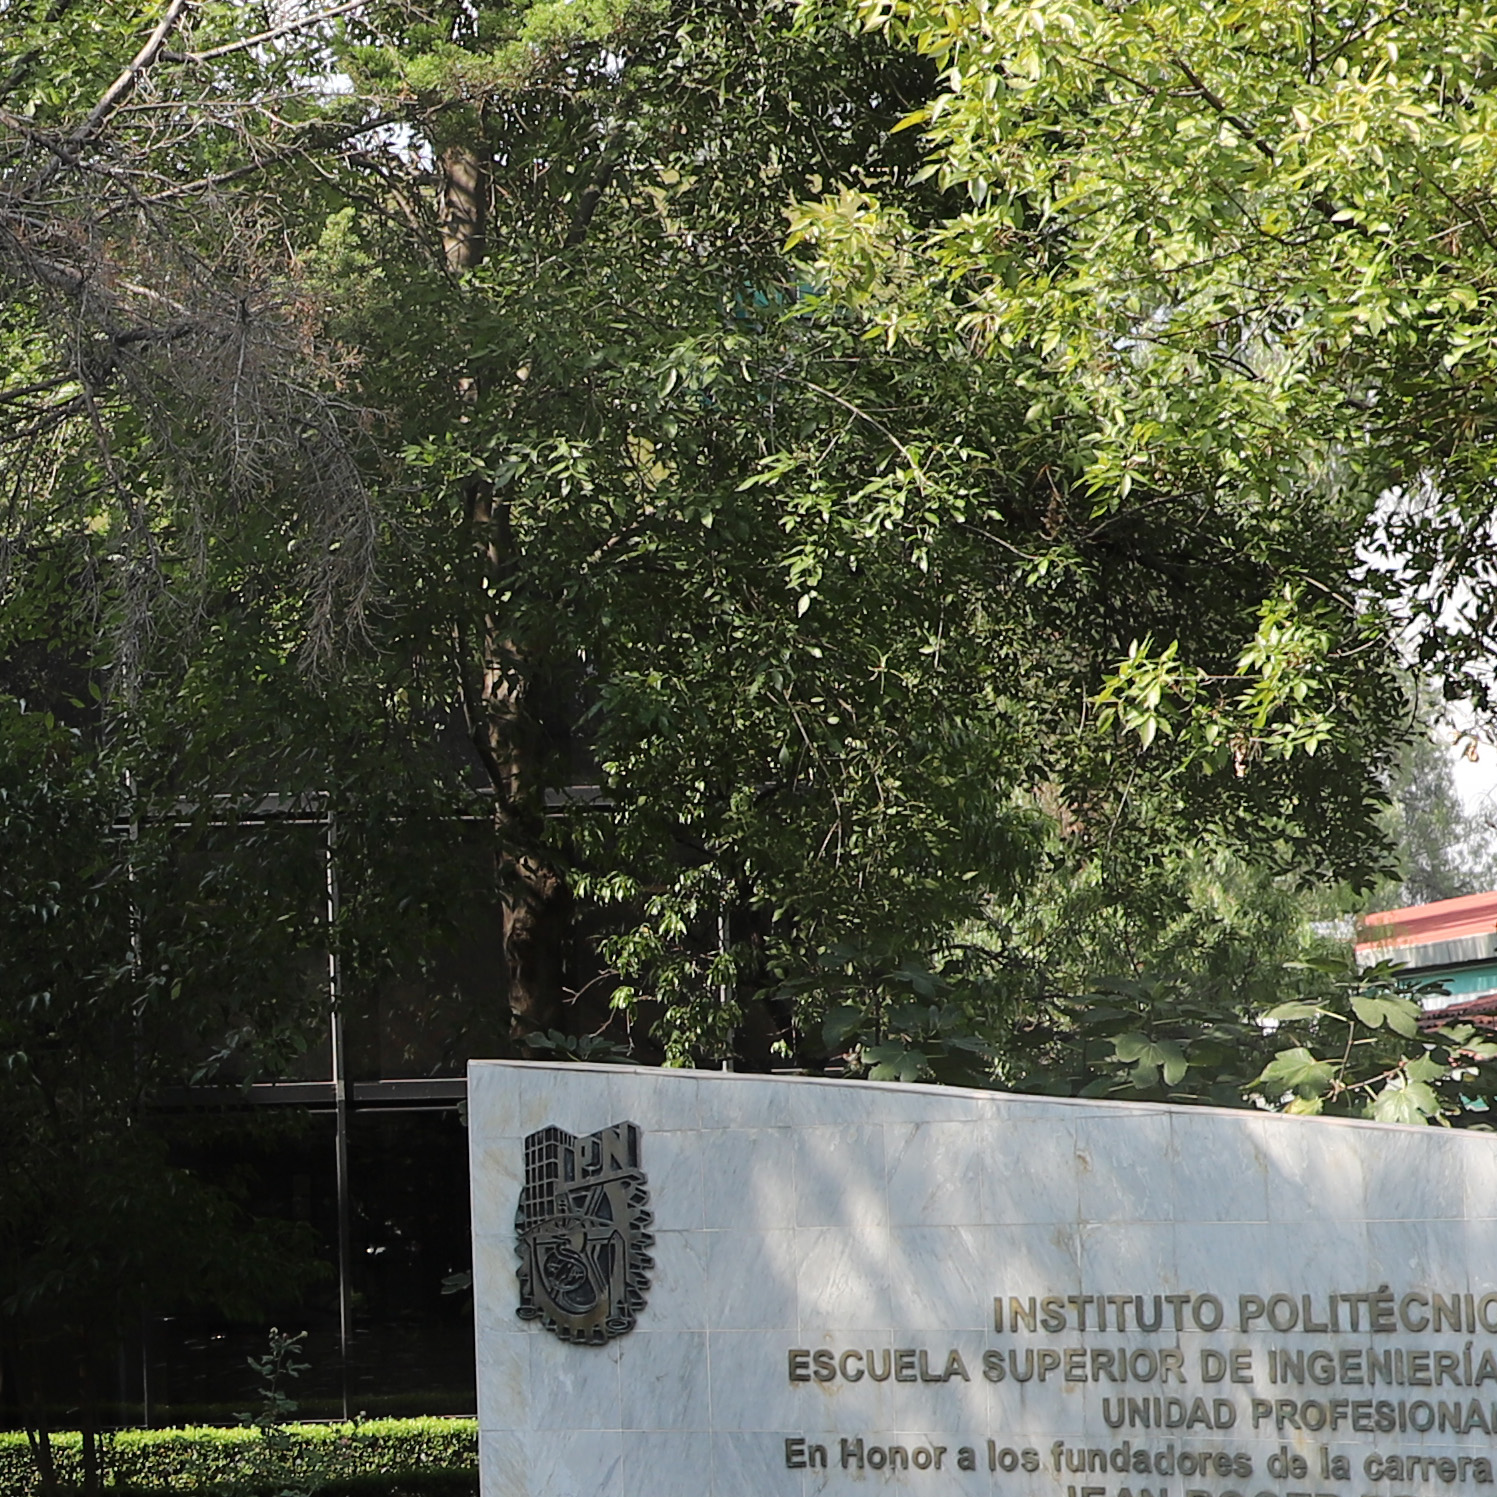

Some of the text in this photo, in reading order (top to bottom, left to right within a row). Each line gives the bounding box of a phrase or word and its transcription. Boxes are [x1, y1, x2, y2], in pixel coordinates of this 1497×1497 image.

[994, 1294, 1224, 1333] INSTITUTO
[787, 1348, 971, 1384] ESCUELA
[981, 1347, 1186, 1384] SUPERIOR
[1201, 1348, 1253, 1384] DE
[1102, 1397, 1237, 1431] UNIDAD
[785, 1437, 828, 1469] En
[840, 1438, 947, 1472] Honor
[957, 1446, 977, 1471] a
[988, 1439, 1040, 1475] los
[1051, 1441, 1253, 1478] fundadores
[1267, 1444, 1308, 1480] de
[1320, 1446, 1351, 1481] la
[1364, 1453, 1493, 1484] carrera
